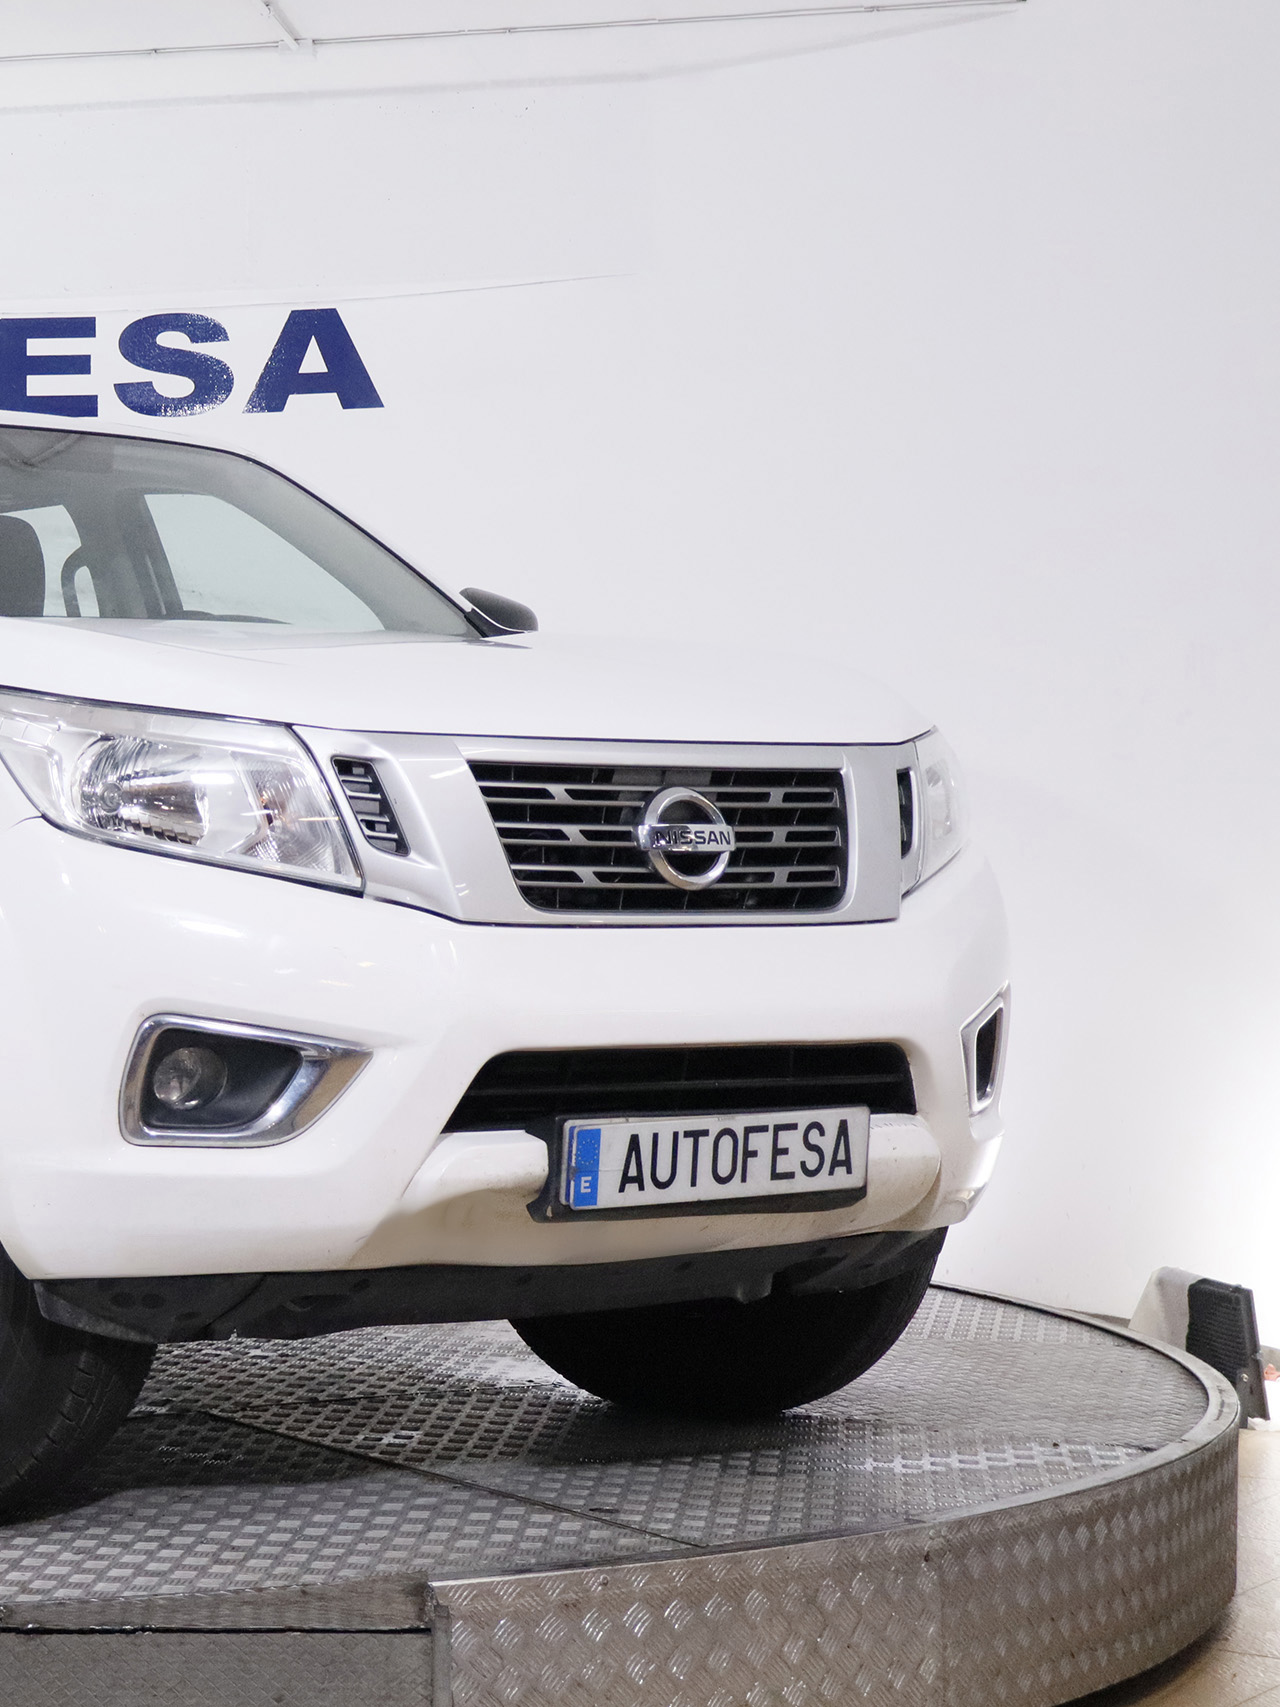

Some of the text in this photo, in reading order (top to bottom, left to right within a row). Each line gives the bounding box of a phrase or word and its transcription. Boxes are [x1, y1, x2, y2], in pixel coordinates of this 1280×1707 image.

[654, 830, 731, 846] NISSAN
[618, 1119, 853, 1193] AUTOFESA
[580, 1177, 592, 1193] E
